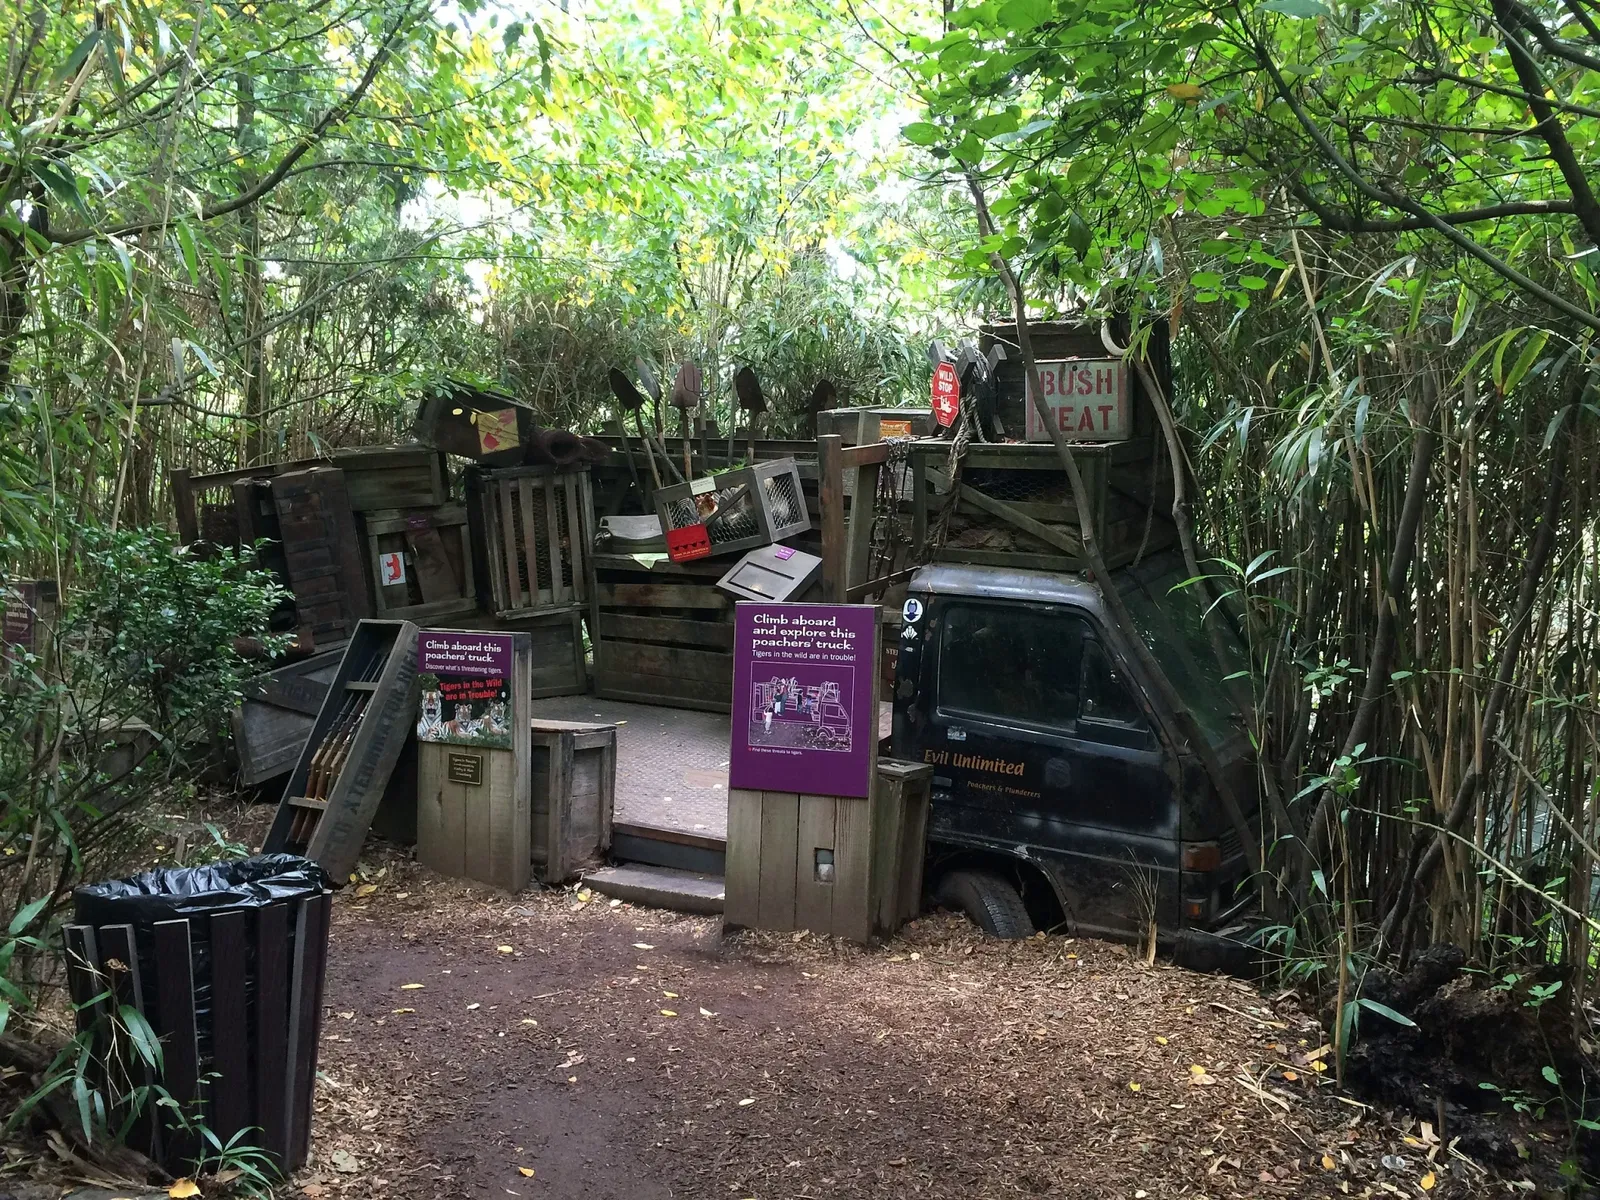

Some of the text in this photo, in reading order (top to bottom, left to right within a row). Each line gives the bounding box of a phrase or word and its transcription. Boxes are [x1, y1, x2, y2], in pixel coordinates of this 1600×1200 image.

[938, 370, 953, 382] WILD
[1040, 368, 1112, 396] BUSH
[938, 380, 953, 394] STOP
[754, 613, 836, 626] Climb aboard
[753, 625, 856, 640] and explore this
[426, 640, 502, 652] Climb aboard this
[752, 637, 854, 650] poachers' truck.
[425, 651, 494, 662] poachers' truck.
[752, 650, 772, 658] Tigers
[830, 653, 856, 661] trouble!
[461, 666, 487, 674] threatening
[440, 683, 461, 692] Tigers
[486, 679, 502, 688] Wild
[468, 690, 497, 699] Trouble!
[924, 750, 1025, 776] Evil Unlimited
[967, 780, 996, 791] Poachers
[1005, 786, 1041, 798] Plunderers
